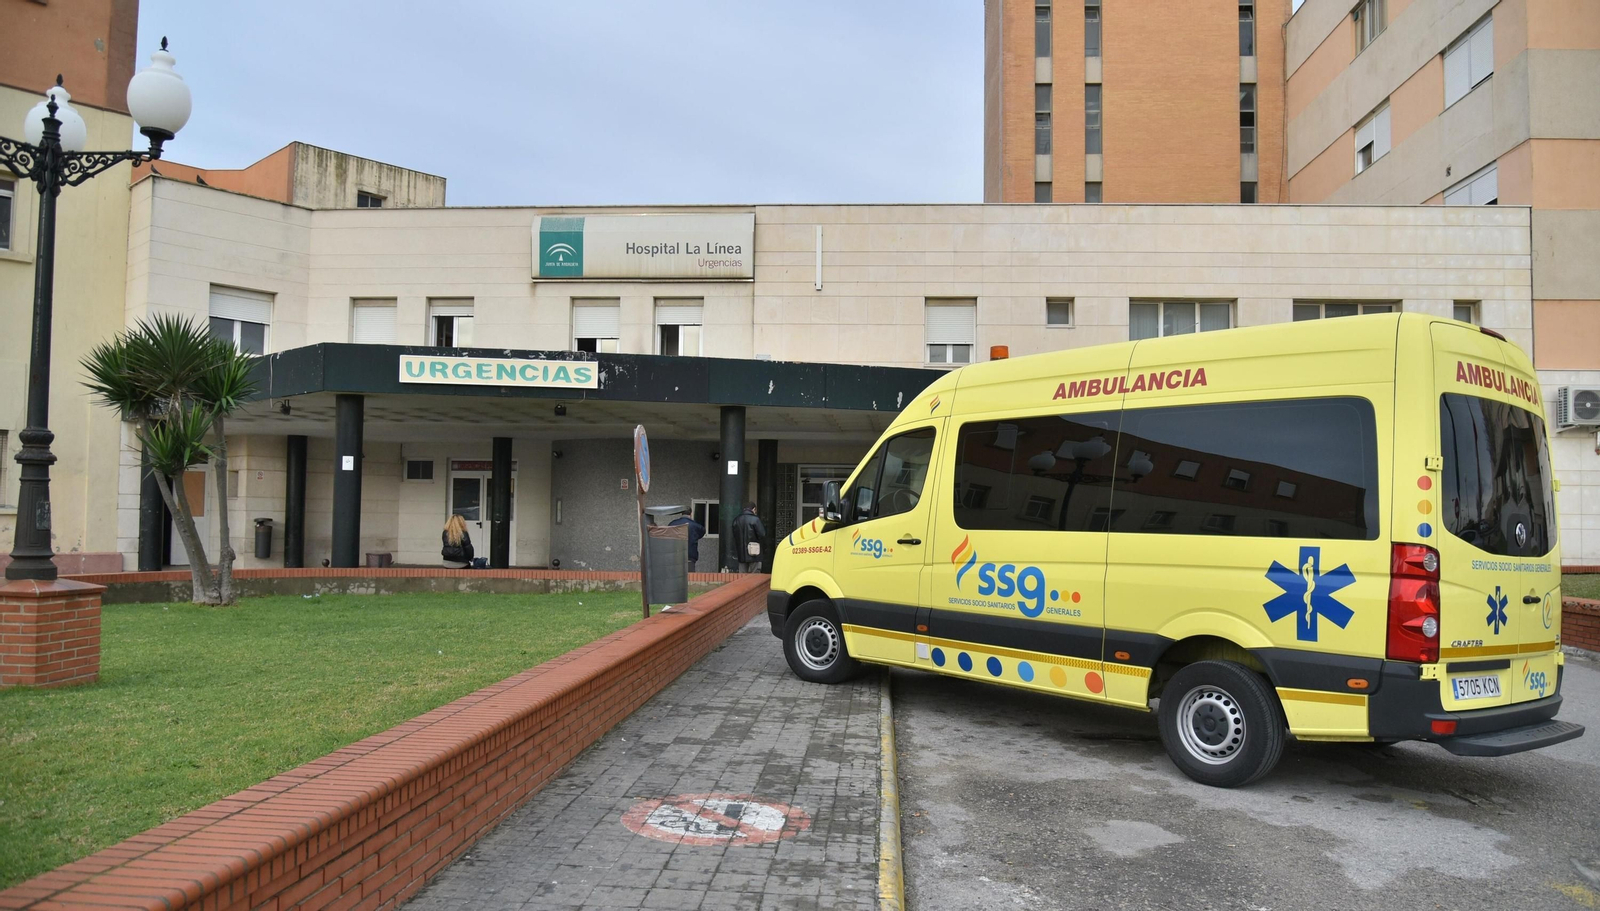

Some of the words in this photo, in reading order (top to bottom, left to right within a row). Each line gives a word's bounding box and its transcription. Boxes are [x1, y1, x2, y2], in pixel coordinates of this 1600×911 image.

[626, 242, 680, 257] Hospital
[685, 243, 700, 255] La
[706, 242, 742, 255] Línea
[698, 258, 743, 269] Urgencias
[405, 361, 592, 384] URGENCIAS
[1052, 367, 1208, 400] AMBULANCIA
[1456, 360, 1539, 407] AMBULANCIA
[792, 546, 832, 554] 02389-SSGE-A2
[1471, 560, 1498, 571] SERVICIOS
[1498, 562, 1512, 572] SOCIO
[1513, 563, 1534, 572] SANITARIOS
[948, 597, 971, 606] SERVICIOS
[972, 599, 986, 607] SOCIO
[987, 601, 1015, 610] SANITARIOS
[1046, 606, 1081, 617] GENERALES
[1450, 639, 1483, 648] CRAFTER
[1458, 678, 1482, 697] 5705
[1482, 677, 1500, 694] KCN
